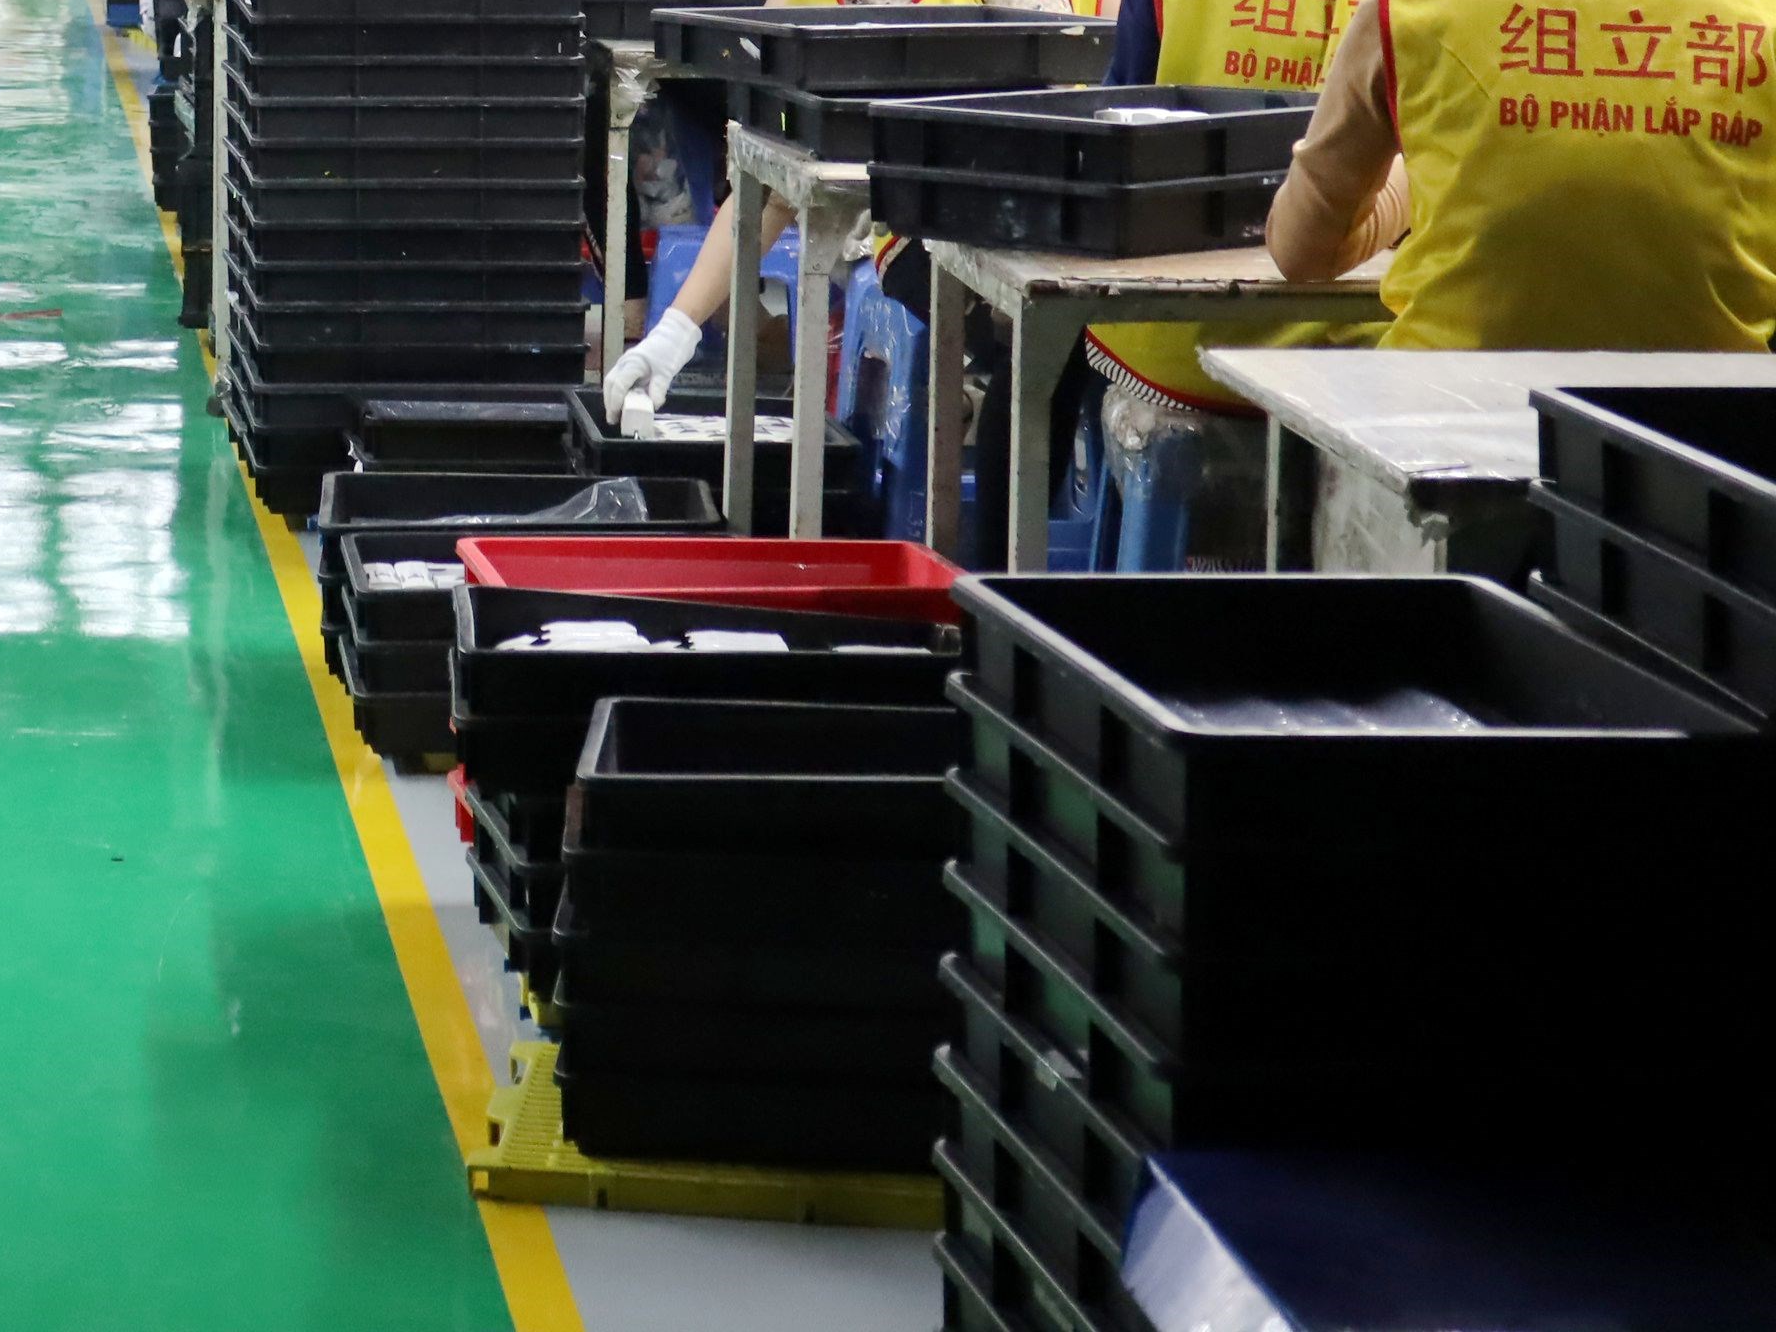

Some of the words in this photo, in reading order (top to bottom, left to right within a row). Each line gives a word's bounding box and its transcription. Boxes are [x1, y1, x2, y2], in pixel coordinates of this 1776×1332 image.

[1224, 47, 1258, 84] BỘ
[1499, 3, 1768, 94] 组立部
[1499, 93, 1540, 134] BỘ
[1550, 97, 1634, 138] PHẬN
[1644, 95, 1702, 137] LẮP
[1710, 110, 1763, 147] RÁP
